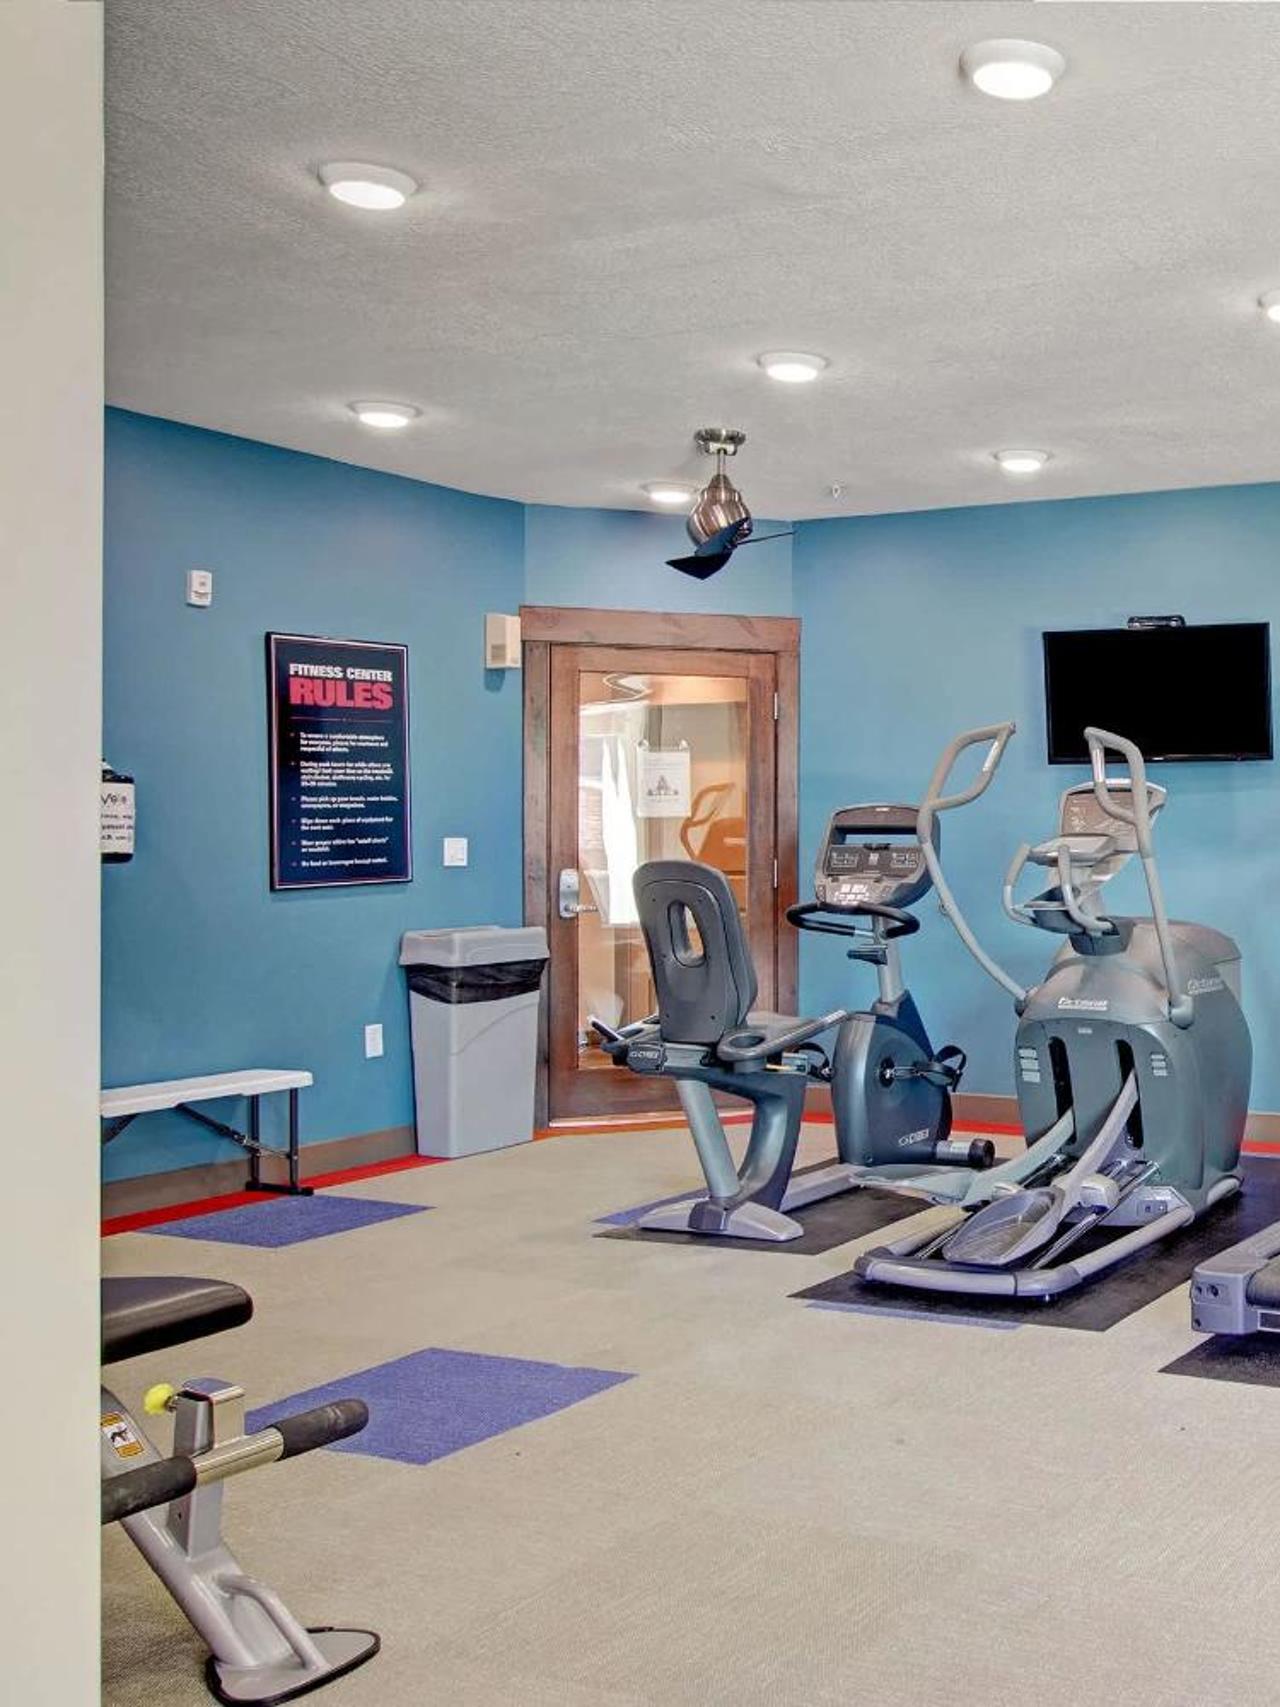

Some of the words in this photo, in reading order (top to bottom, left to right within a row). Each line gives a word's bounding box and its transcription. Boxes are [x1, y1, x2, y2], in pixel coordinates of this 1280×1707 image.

[289, 663, 343, 679] FITNESS
[346, 667, 393, 682] CENTER
[289, 677, 394, 710] RULES
